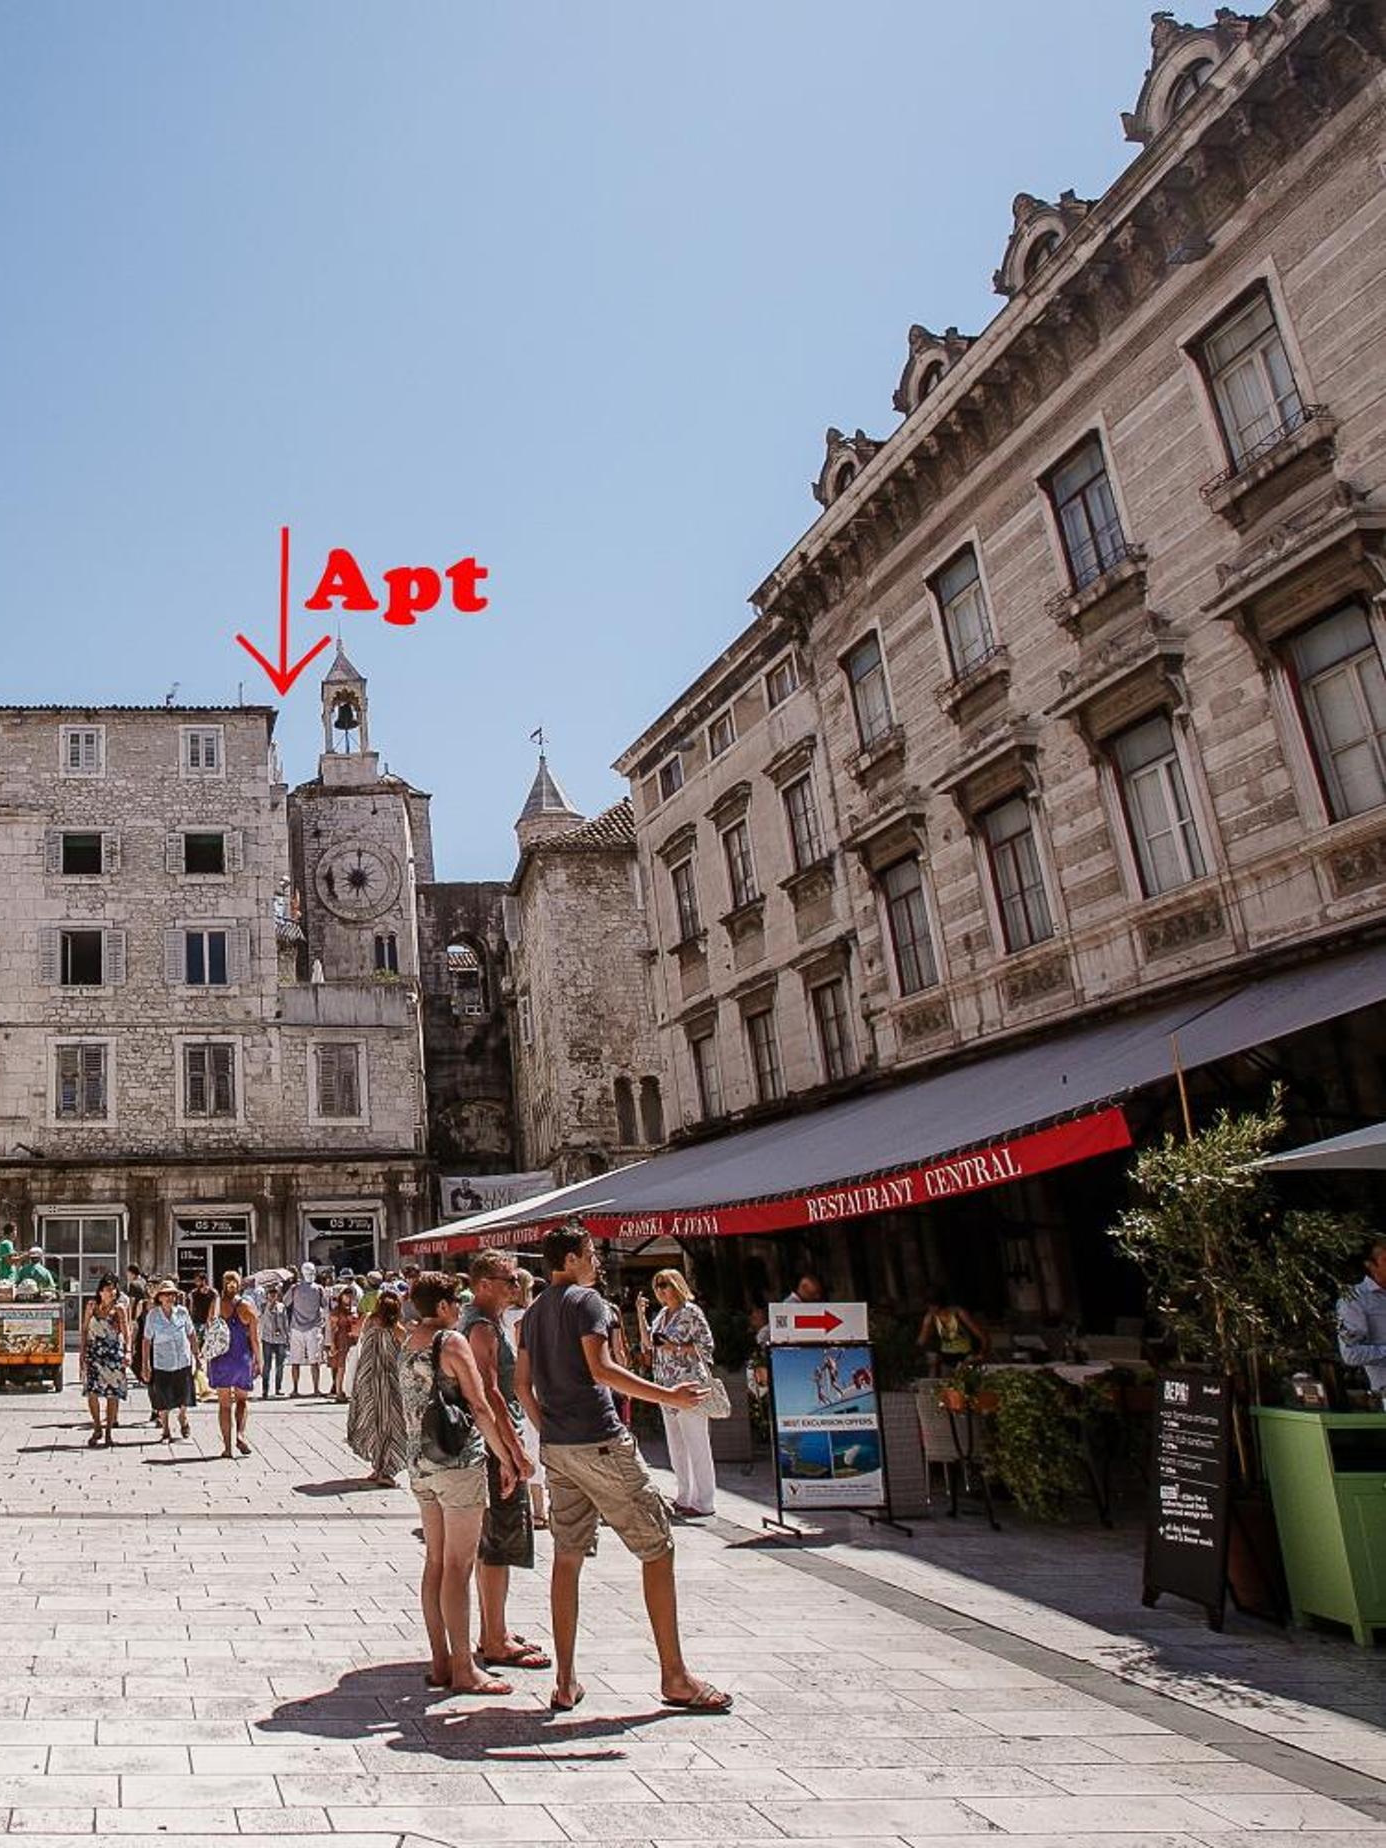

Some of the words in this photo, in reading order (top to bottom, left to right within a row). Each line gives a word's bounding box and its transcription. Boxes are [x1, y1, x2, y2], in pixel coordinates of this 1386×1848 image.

[806, 1177, 914, 1223] RESTAURANT
[924, 1147, 1022, 1197] CENTRAL
[671, 1215, 719, 1236] KAVANA
